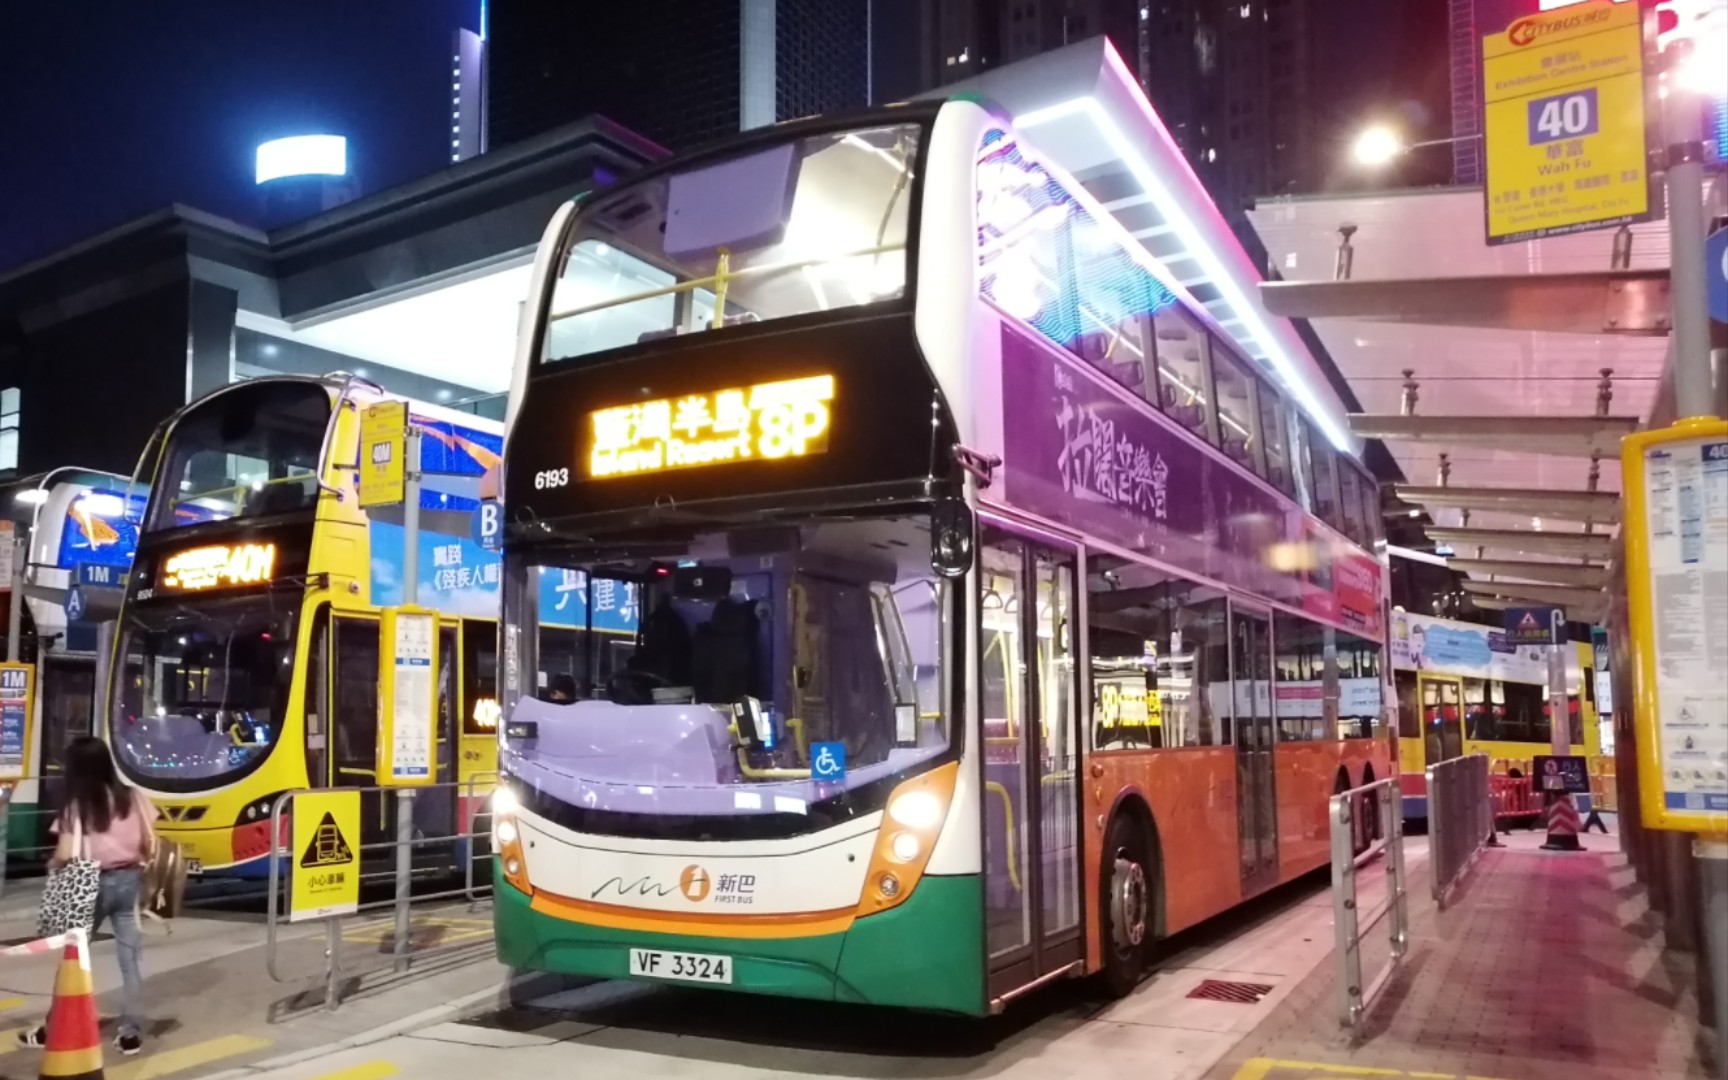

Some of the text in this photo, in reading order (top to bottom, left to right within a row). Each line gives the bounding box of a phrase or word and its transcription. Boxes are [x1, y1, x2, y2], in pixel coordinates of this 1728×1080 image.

[1495, 55, 1629, 90] Exhibition Centre Station
[1537, 95, 1589, 137] 40
[1538, 158, 1591, 176] Wah Fu
[760, 400, 827, 458] 8P
[534, 467, 569, 490] 6193
[481, 504, 498, 536] B
[87, 566, 110, 583] 1M
[228, 543, 276, 585] 40M
[67, 589, 81, 612] A
[3, 671, 25, 688] 1M
[717, 873, 755, 893] 新巴
[714, 895, 753, 904] FIRST BUS
[638, 951, 726, 982] VF 3324
